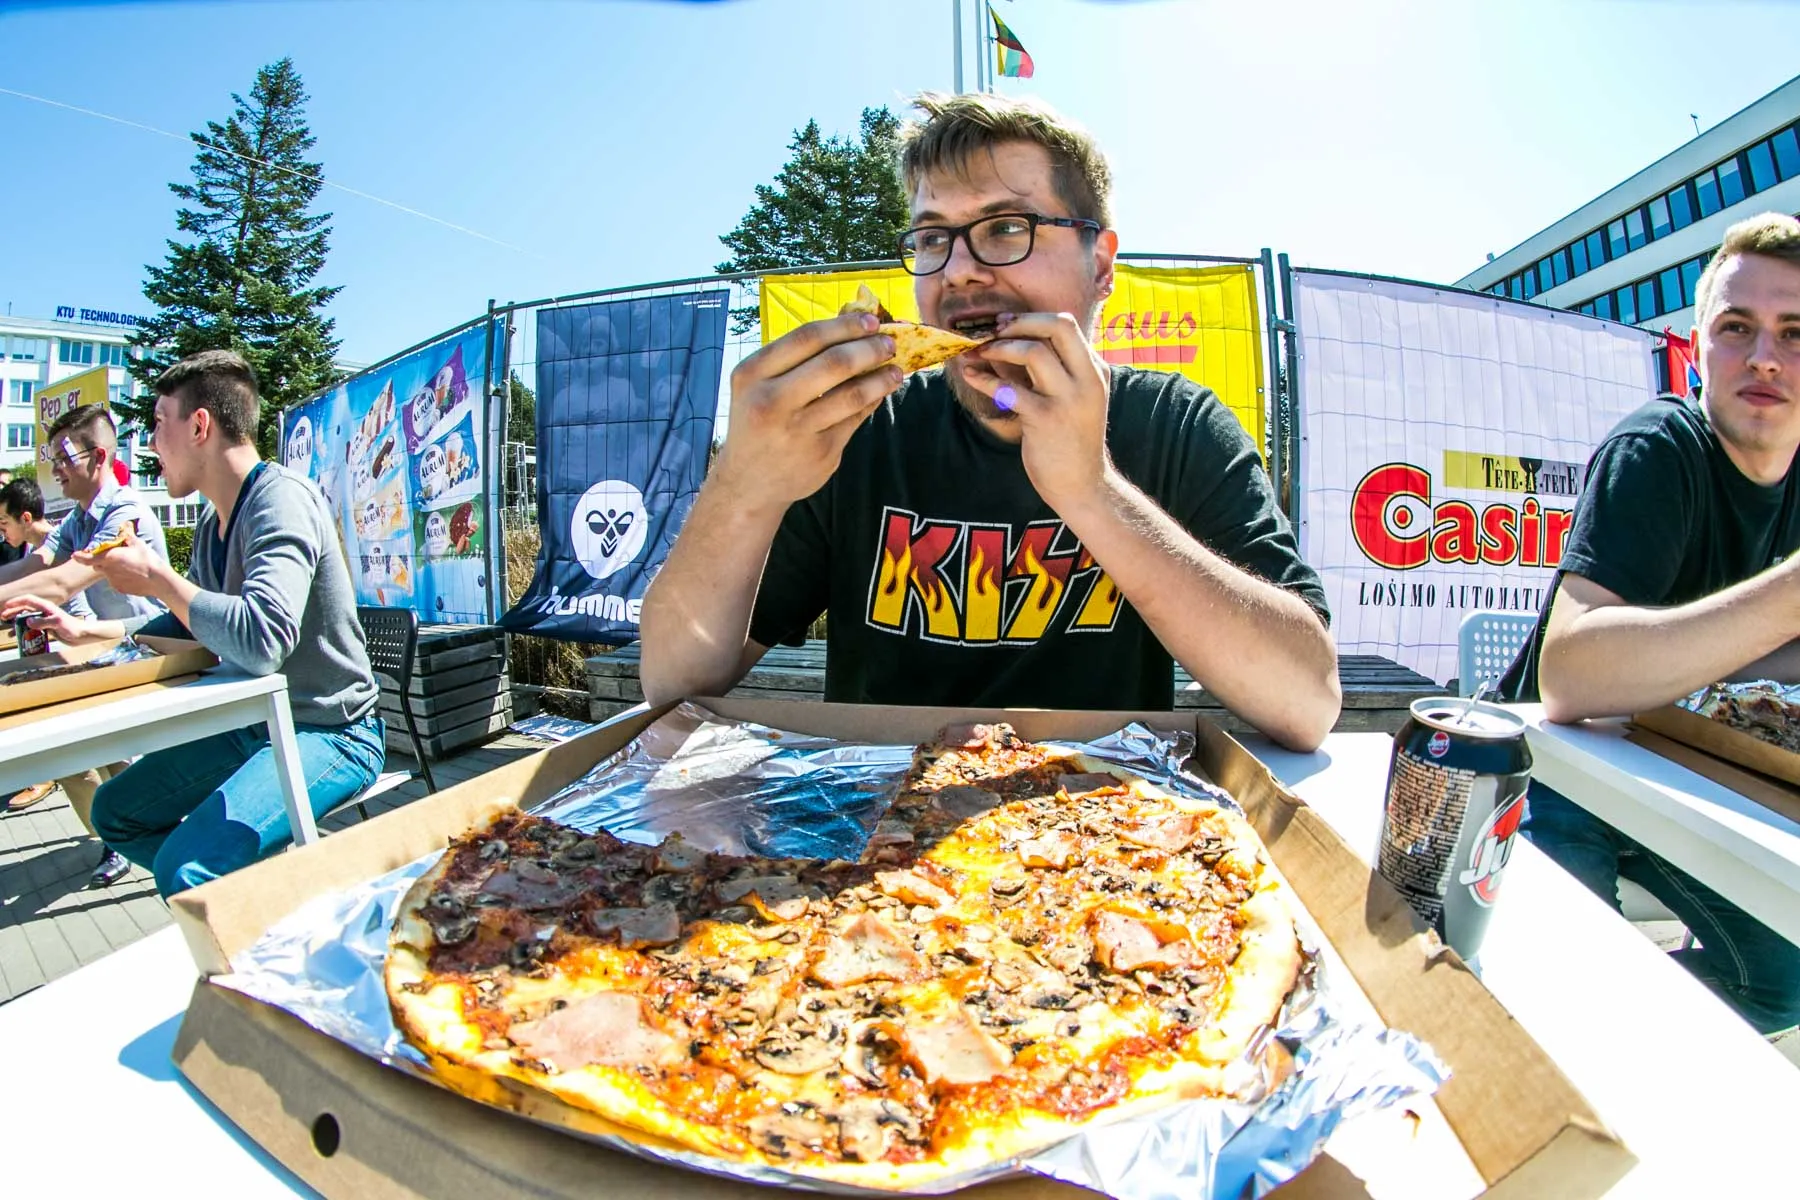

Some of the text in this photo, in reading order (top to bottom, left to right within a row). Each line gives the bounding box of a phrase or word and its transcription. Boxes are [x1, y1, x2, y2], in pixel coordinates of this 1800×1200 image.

[57, 305, 75, 318] KTU
[40, 389, 81, 421] Peper
[413, 392, 435, 422] AURUM
[421, 453, 445, 479] AURUM
[426, 523, 447, 539] AURUM
[1350, 462, 1574, 570] Casi
[538, 586, 643, 623] humme
